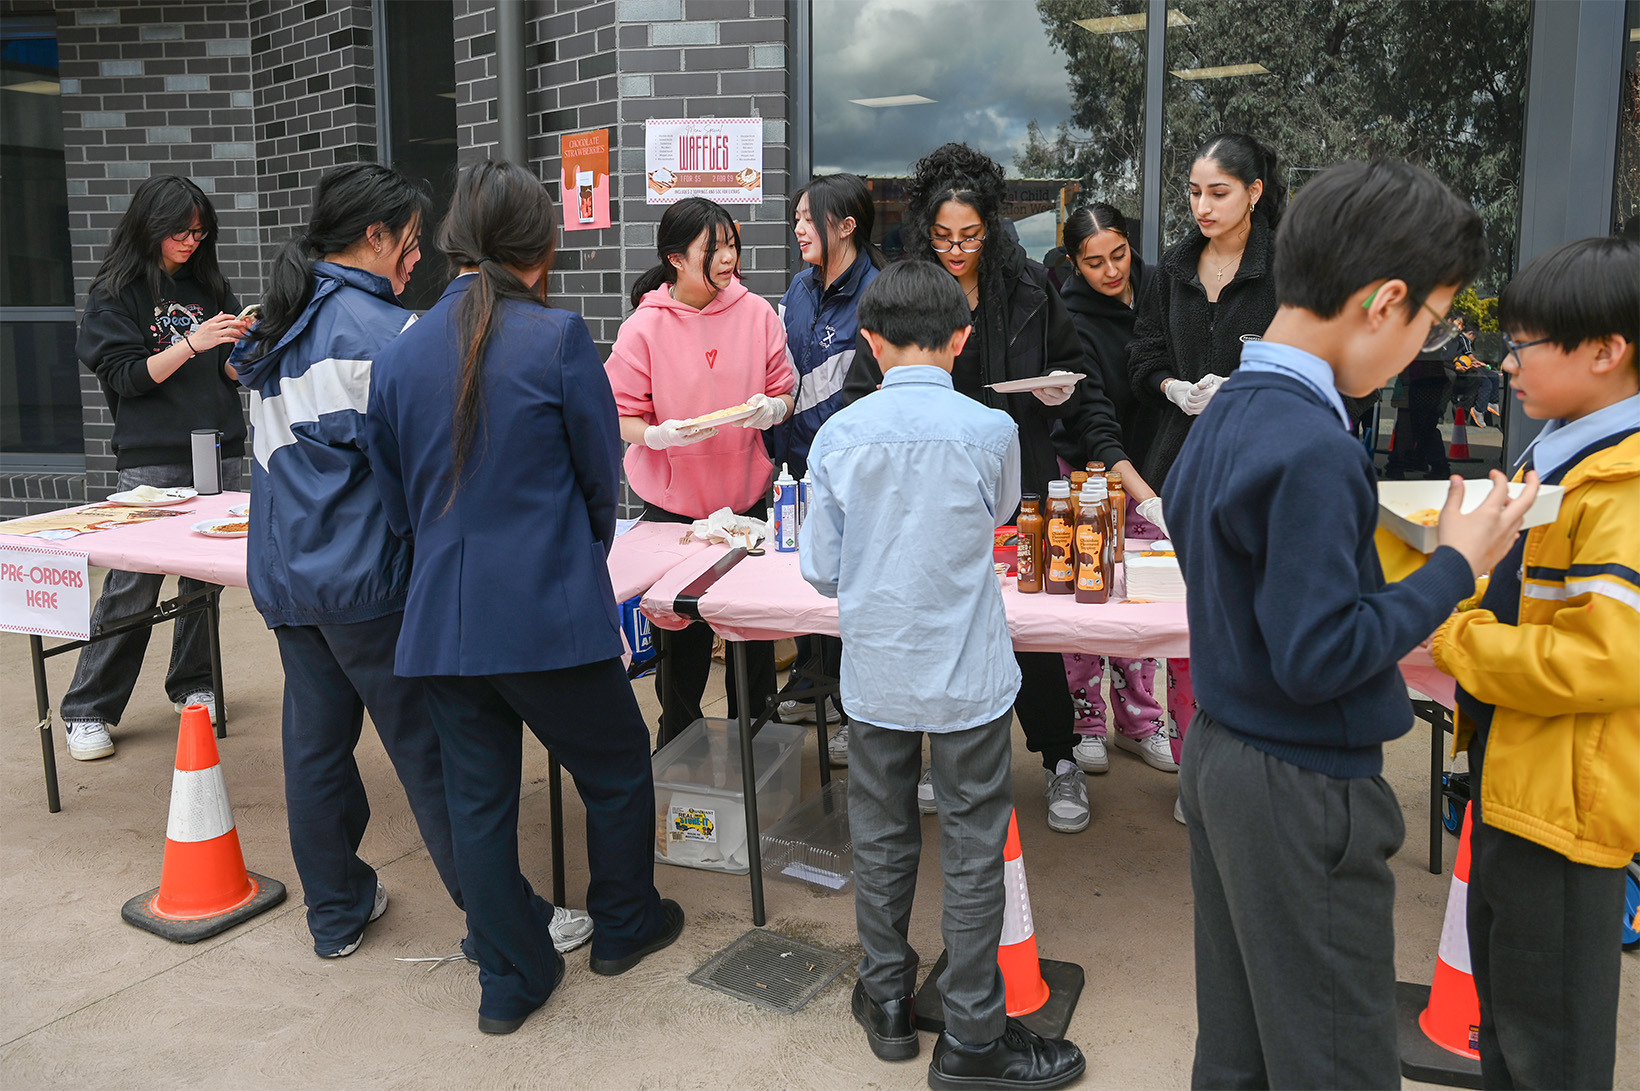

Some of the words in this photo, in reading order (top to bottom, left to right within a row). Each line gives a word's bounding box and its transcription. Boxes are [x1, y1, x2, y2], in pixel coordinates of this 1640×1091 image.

[568, 136, 600, 149] CHOCOLATE
[563, 145, 606, 158] STRAWBERRIES
[679, 135, 729, 171] WAFFLES
[683, 175, 694, 183] FOR
[716, 175, 727, 183] FOR
[1020, 189, 1049, 201] Child
[1, 563, 84, 588] PRE-ORDERS
[26, 589, 58, 610] HERE
[680, 817, 709, 827] STORE-IT
